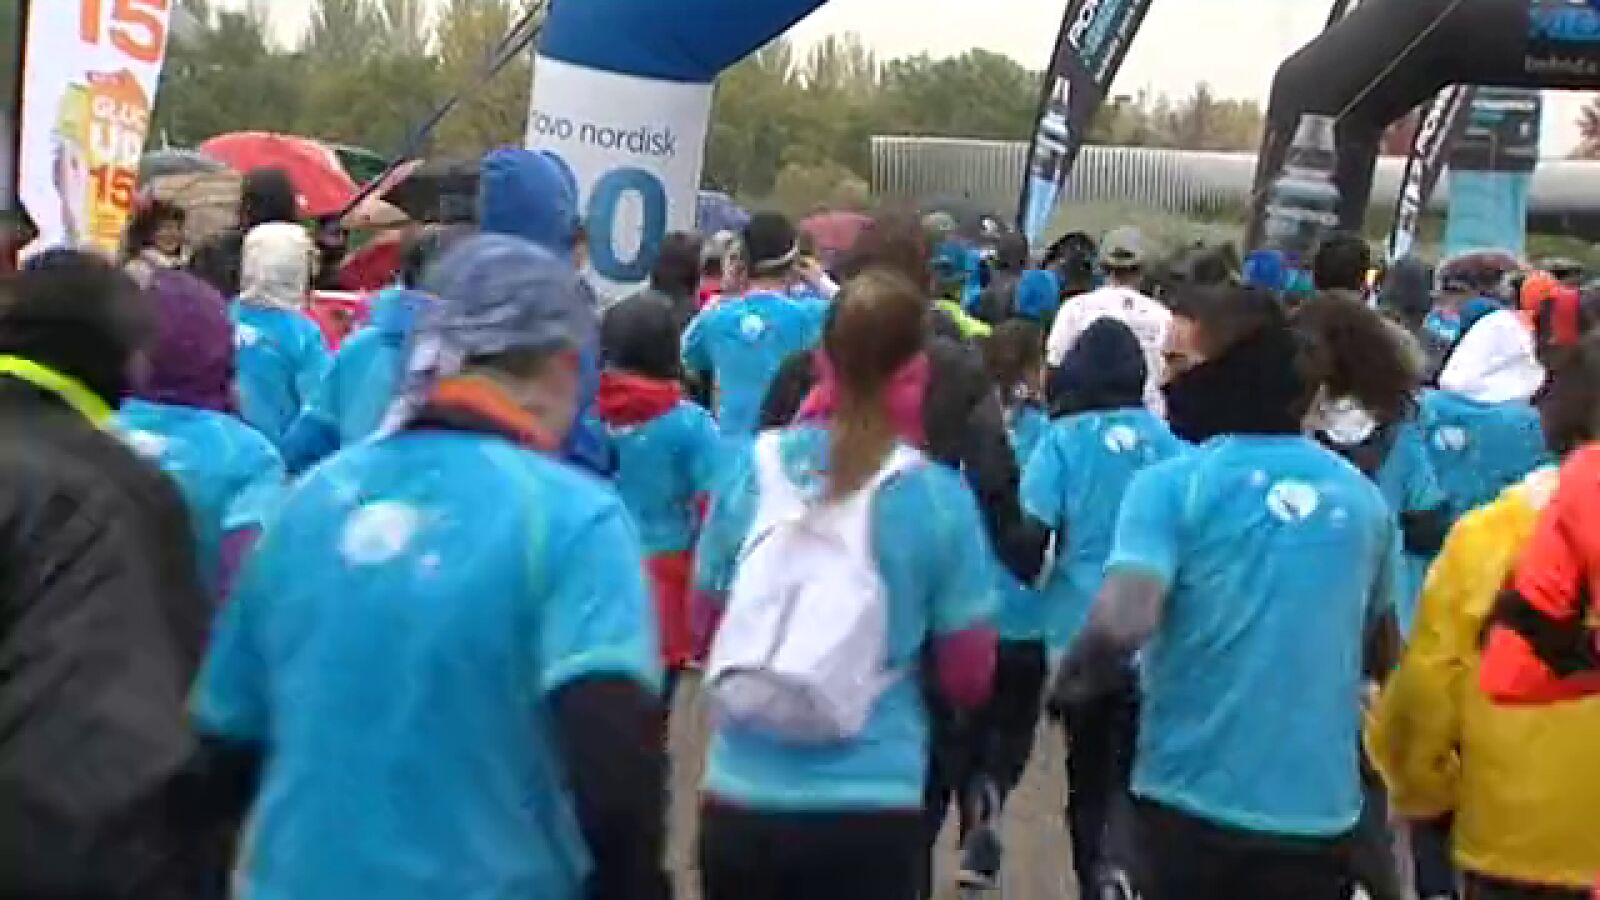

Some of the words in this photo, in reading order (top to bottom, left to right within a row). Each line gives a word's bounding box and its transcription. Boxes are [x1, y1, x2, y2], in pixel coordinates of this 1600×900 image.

[79, 0, 165, 62] 15
[532, 110, 573, 140] ovo
[579, 122, 676, 156] nordisk
[90, 165, 135, 209] 15
